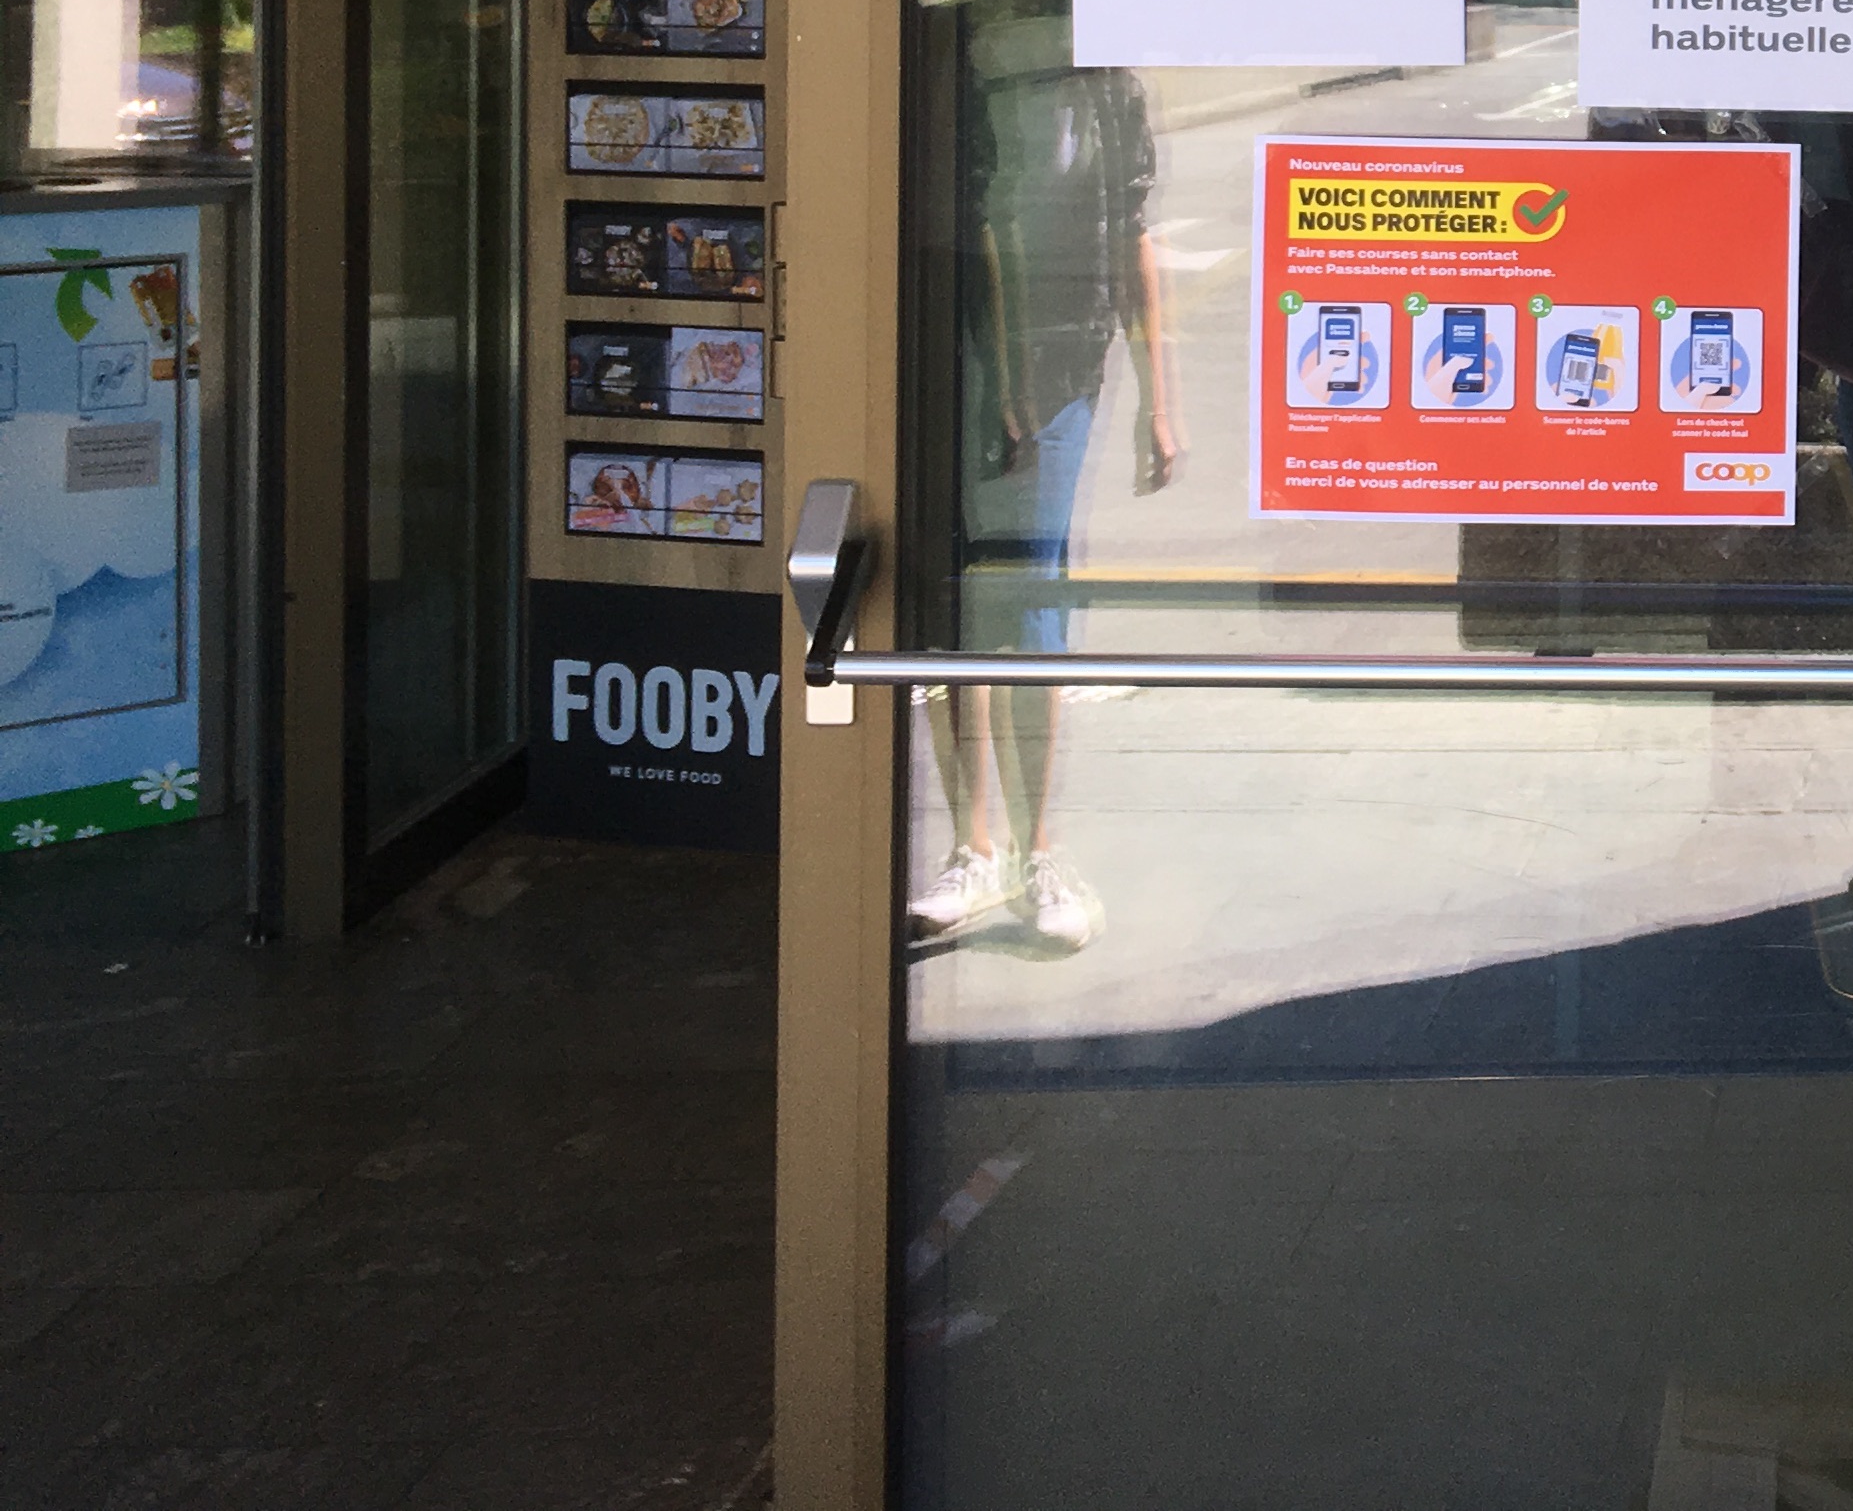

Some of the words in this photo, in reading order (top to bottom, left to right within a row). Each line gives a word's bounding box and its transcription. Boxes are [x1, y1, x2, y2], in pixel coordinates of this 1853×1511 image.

[1289, 158, 1362, 173] Nouveau
[1365, 160, 1465, 175] coronavirus
[1298, 187, 1366, 208] VOICI
[1371, 189, 1501, 210] COMMENT
[1298, 211, 1367, 232] NOUS
[1287, 246, 1326, 260] Faire
[1329, 249, 1355, 261] ses
[1357, 249, 1418, 262] courses
[1421, 250, 1457, 263] sans
[1459, 248, 1519, 262] contact
[1287, 264, 1324, 275] avec
[1326, 263, 1408, 277] Passabene
[1411, 264, 1427, 277] et
[1430, 266, 1457, 277] son
[1460, 265, 1556, 280] smartphone.
[1285, 295, 1299, 309] 1.
[1407, 297, 1426, 311] 2.
[1532, 298, 1550, 312] 3.
[1654, 301, 1673, 315] 4.
[1285, 456, 1307, 470] En
[1309, 458, 1339, 470] cas
[1341, 457, 1363, 471] de
[1364, 459, 1438, 474] question
[1695, 462, 1771, 486] coop
[1285, 474, 1333, 488] merci
[1336, 475, 1356, 488] de
[1358, 477, 1399, 490] vous
[1402, 476, 1476, 491] adresser
[1479, 479, 1500, 491] au
[1502, 477, 1585, 494] personnel
[1587, 478, 1609, 491] de
[1611, 479, 1659, 493] vente
[552, 658, 780, 757] FOOBY
[608, 765, 632, 778] WE
[637, 767, 675, 781] LOVE
[680, 770, 722, 785] FOOD
